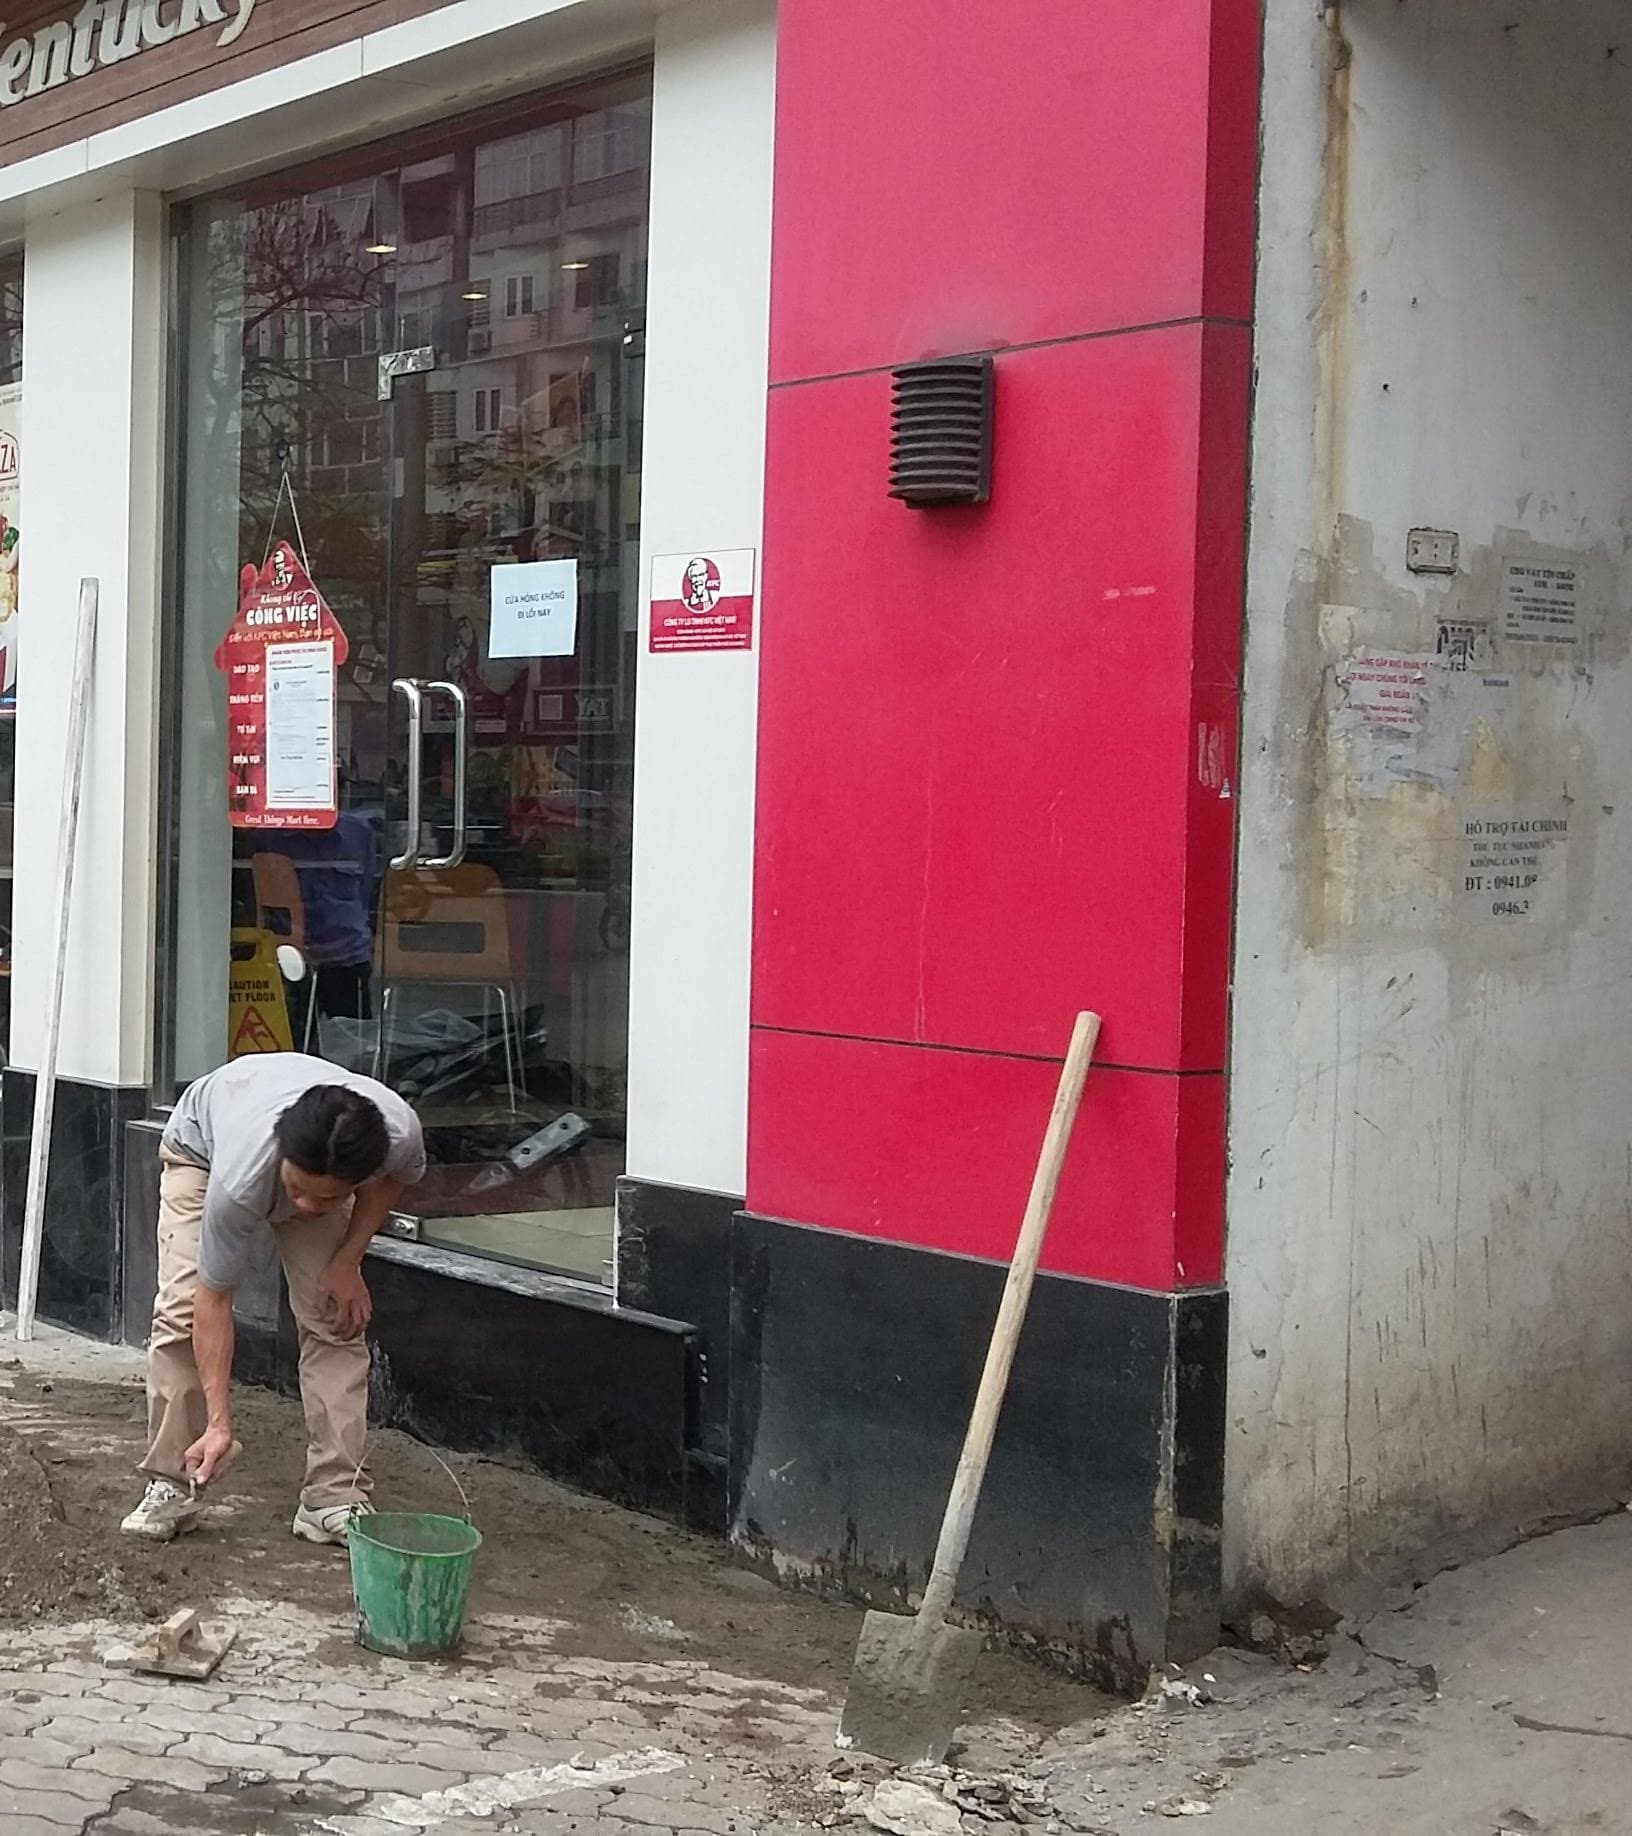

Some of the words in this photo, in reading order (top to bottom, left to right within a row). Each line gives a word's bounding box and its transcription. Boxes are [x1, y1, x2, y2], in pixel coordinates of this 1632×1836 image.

[706, 579, 720, 587] KFC
[246, 606, 283, 626] CÔNG
[285, 601, 318, 628] VIỆC
